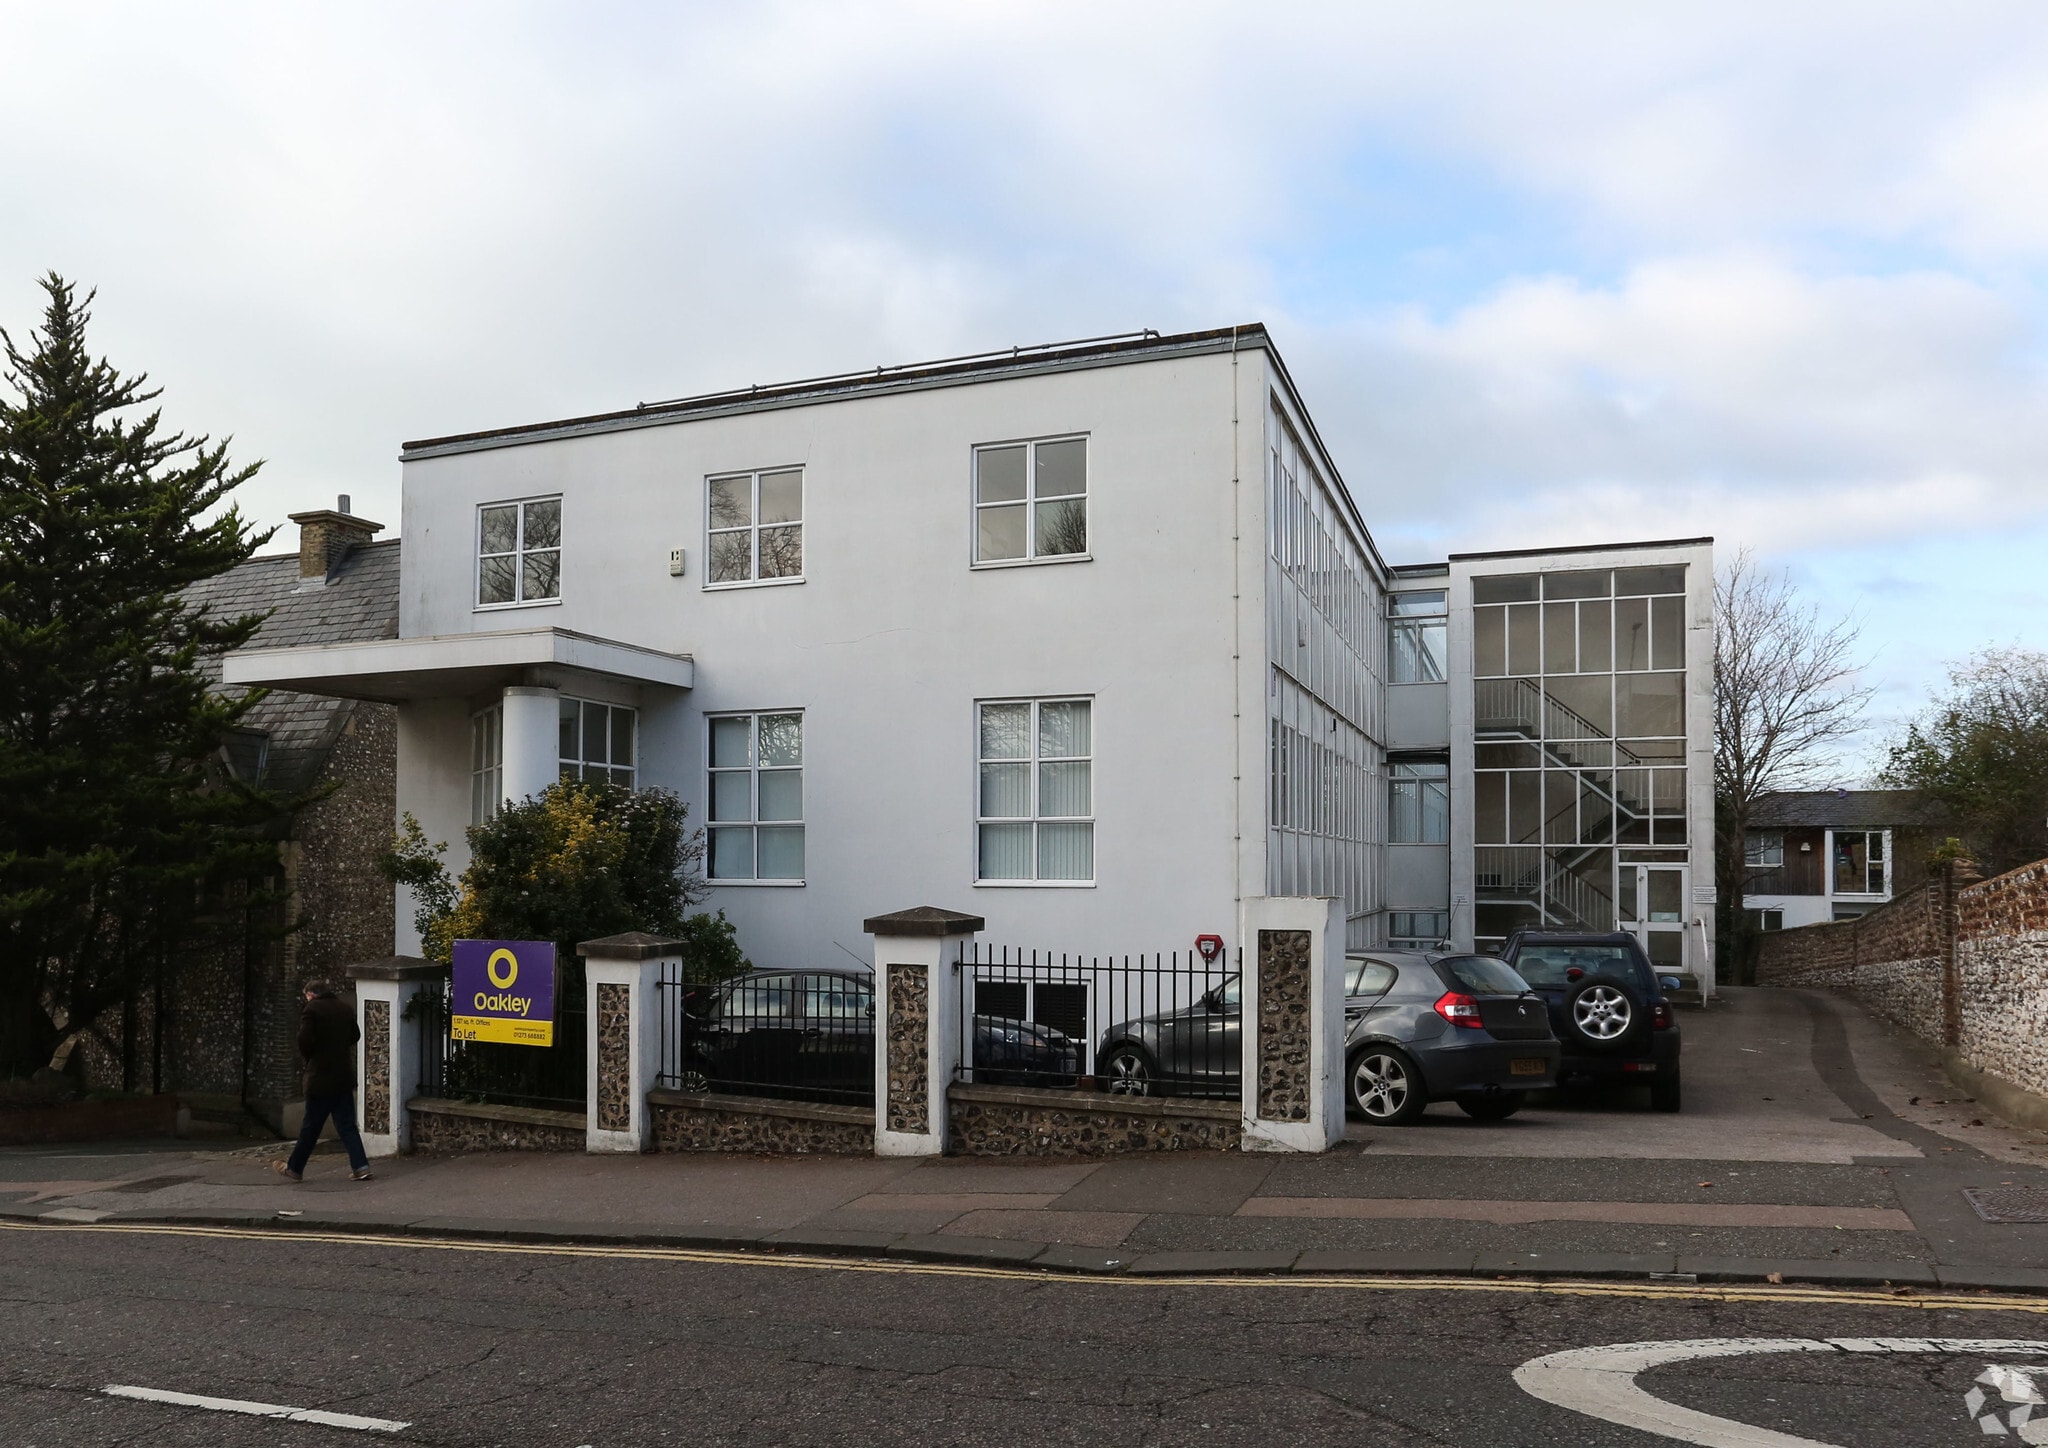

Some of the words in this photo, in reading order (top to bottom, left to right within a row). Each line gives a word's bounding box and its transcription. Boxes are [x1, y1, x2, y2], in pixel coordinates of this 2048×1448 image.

[474, 992, 531, 1017] Oakley
[453, 1027, 462, 1038] To
[464, 1028, 476, 1039] Let
